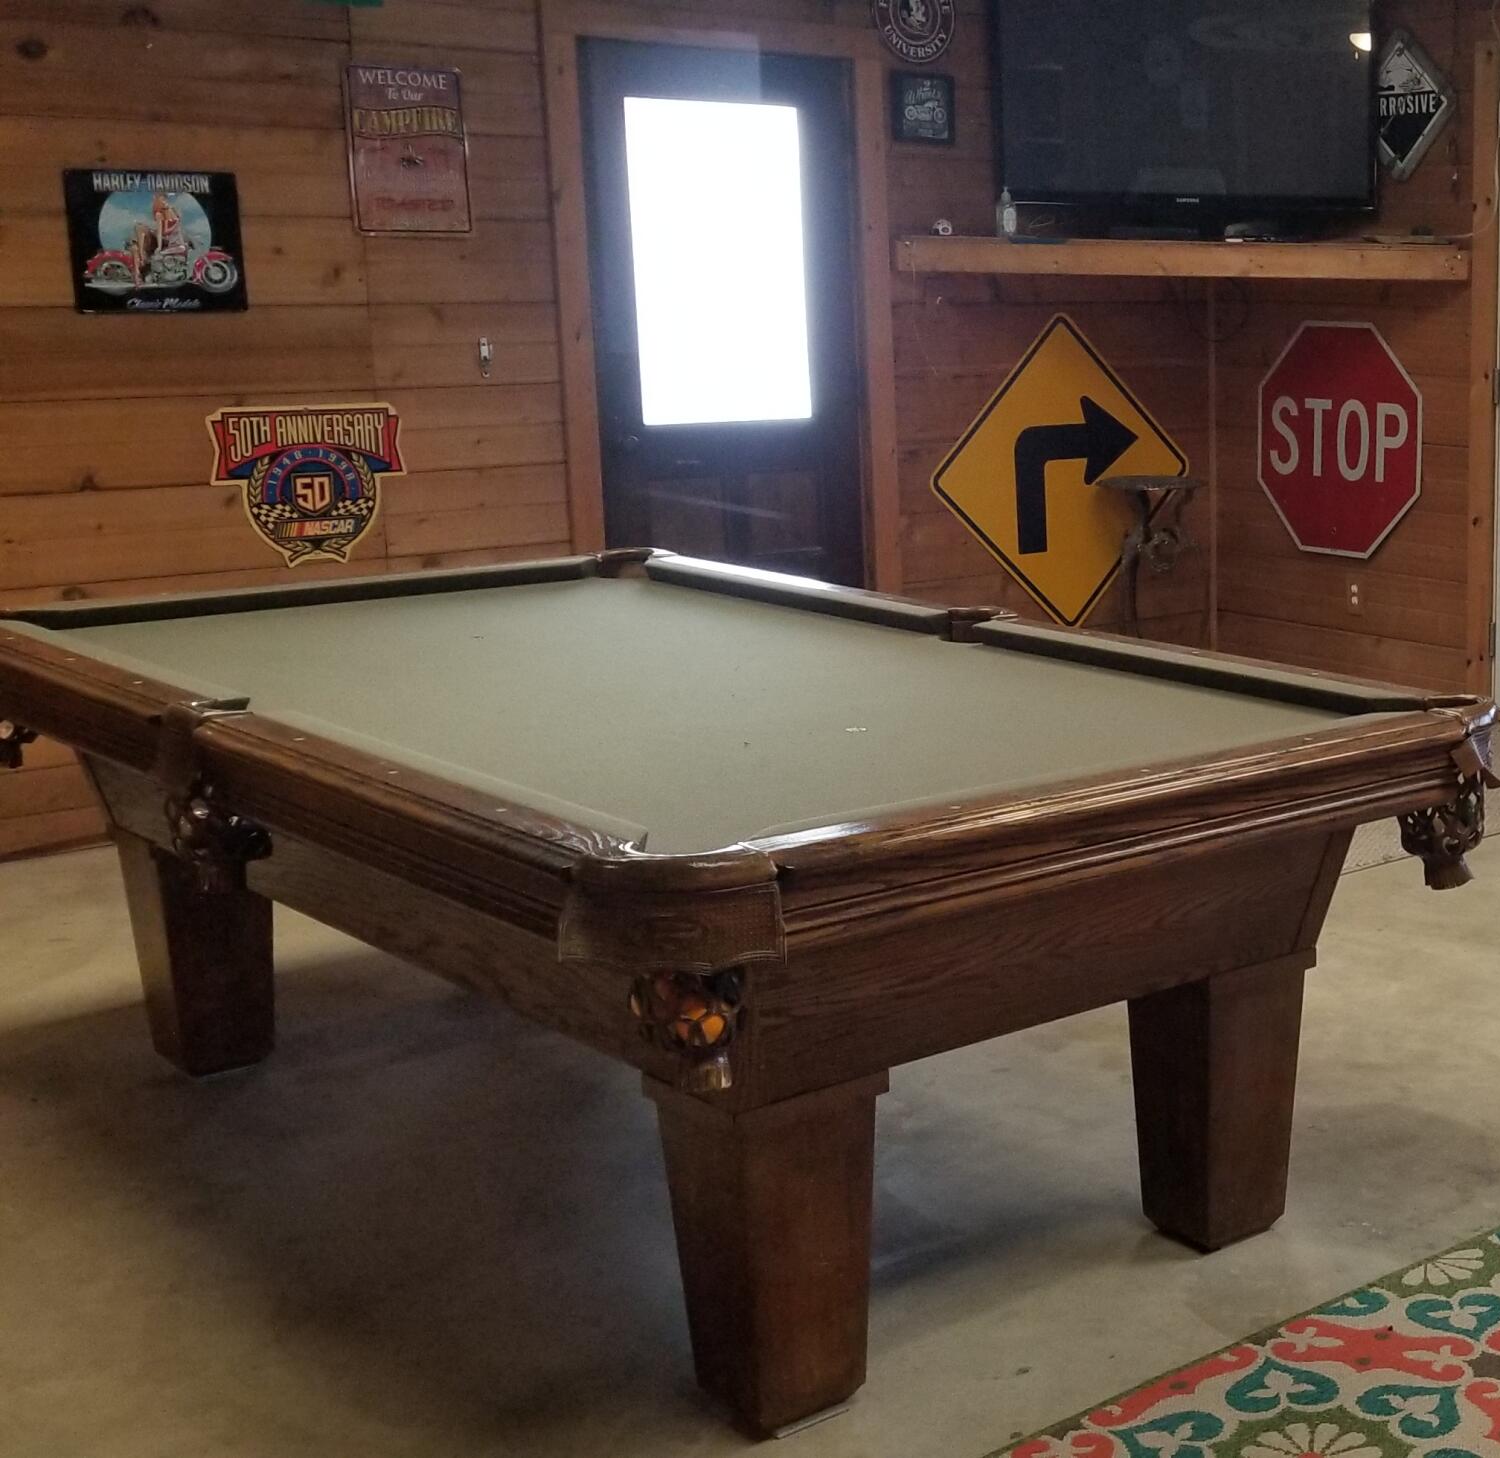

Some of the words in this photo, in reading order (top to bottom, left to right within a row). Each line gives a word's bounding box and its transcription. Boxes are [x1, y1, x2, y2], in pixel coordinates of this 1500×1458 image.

[884, 24, 947, 58] UNIVERSITY
[358, 68, 448, 91] WELCOME
[1379, 93, 1436, 116] RROSIVE
[353, 107, 458, 136] CAMPFIRE
[92, 171, 210, 194] HARLEY-DAVIDSON
[228, 416, 271, 462] 50TH
[275, 413, 384, 456] ANNIVERSARY
[1269, 395, 1409, 483] STOP
[295, 476, 331, 512] 50
[303, 519, 355, 537] NASCAR
